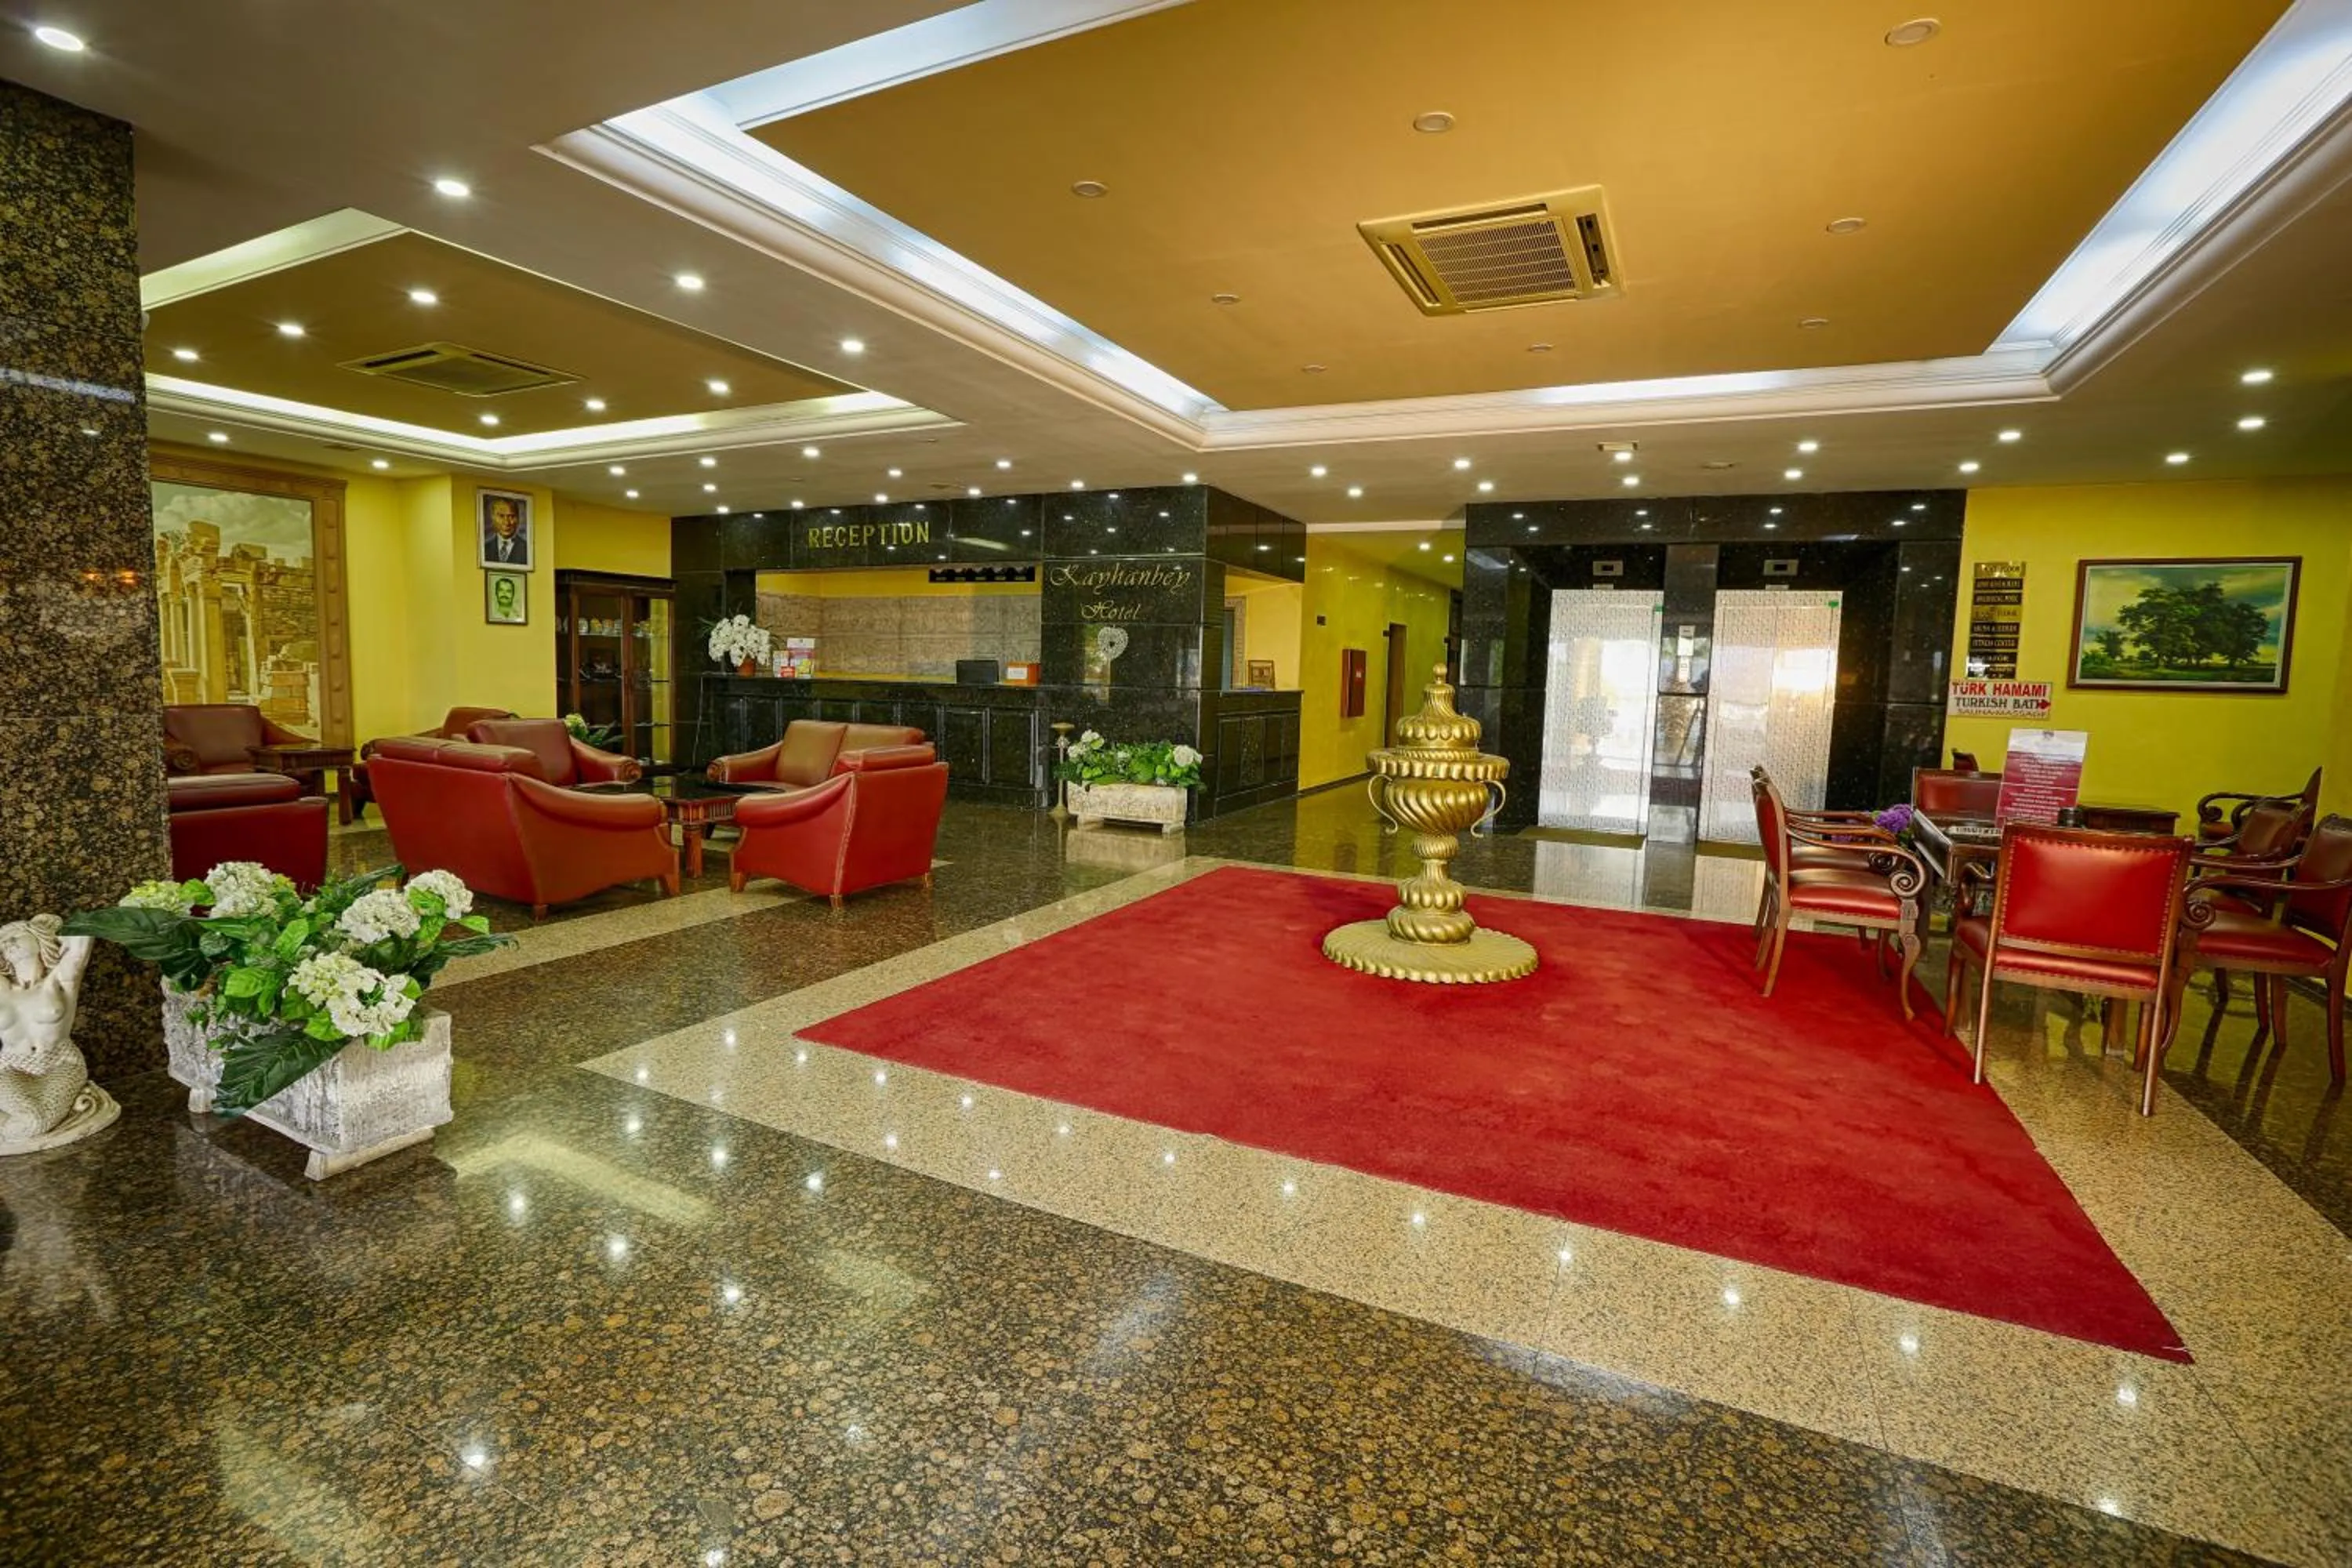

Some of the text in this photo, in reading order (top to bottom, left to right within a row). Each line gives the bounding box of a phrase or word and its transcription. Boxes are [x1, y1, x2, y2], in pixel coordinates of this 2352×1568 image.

[808, 521, 930, 548] RECEPTION
[1050, 562, 1191, 595] Kayhanbey
[1080, 600, 1142, 620] Hotel
[1993, 683, 2047, 697] HAMAMI
[1955, 696, 2008, 708] TURKISH
